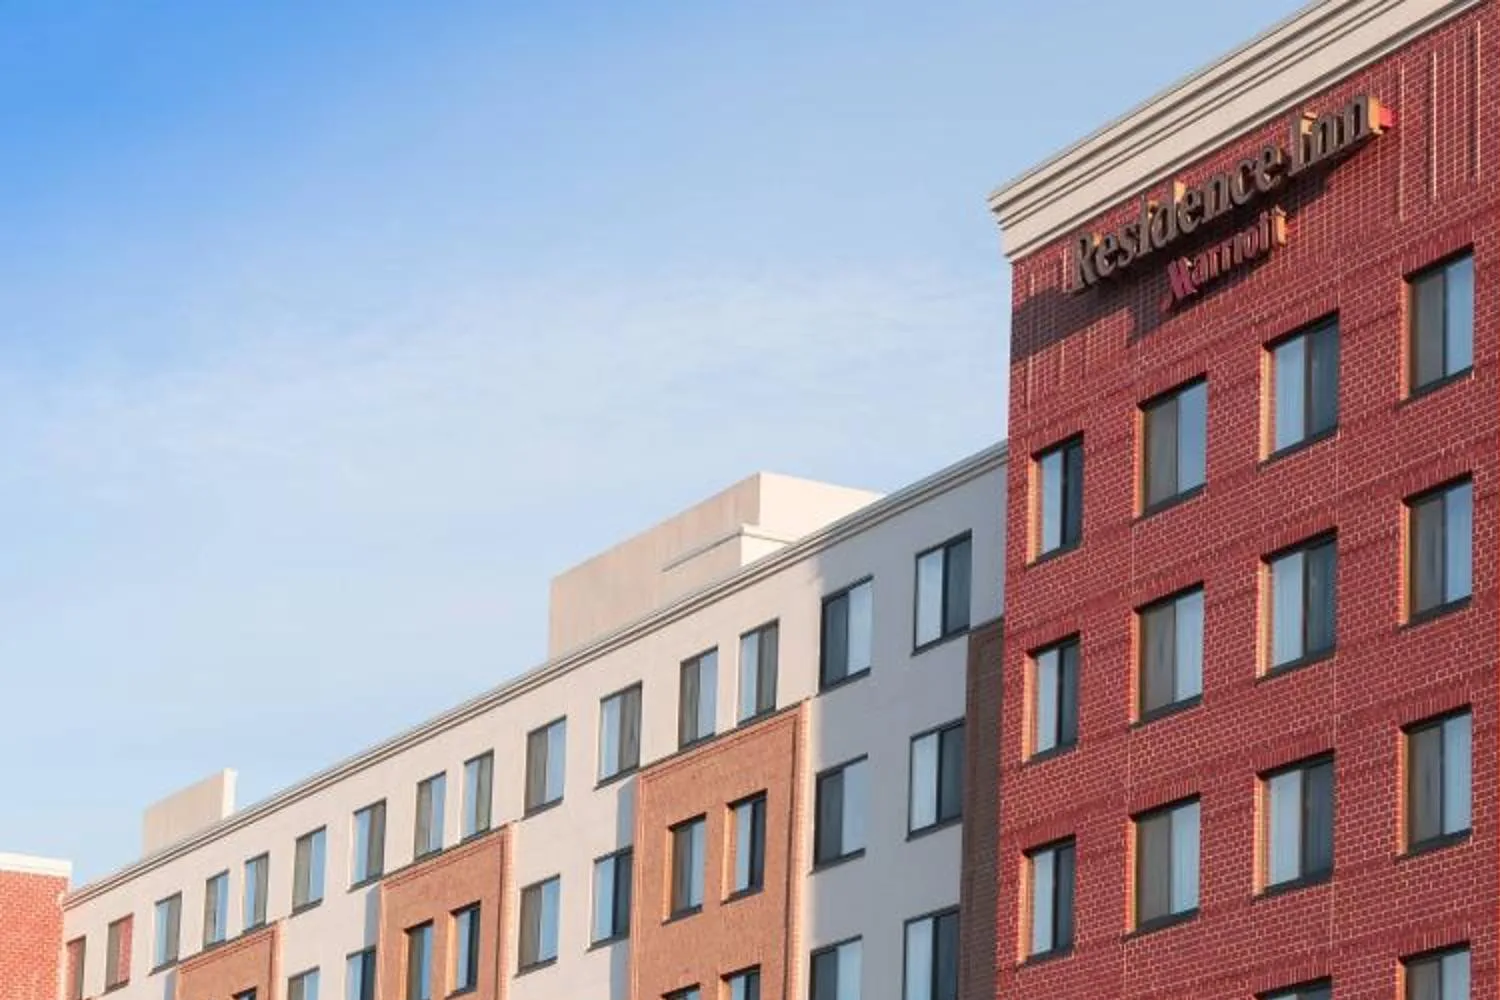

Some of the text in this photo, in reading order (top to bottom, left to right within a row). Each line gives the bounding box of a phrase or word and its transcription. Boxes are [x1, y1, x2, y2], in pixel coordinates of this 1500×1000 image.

[1069, 95, 1382, 293] Residence Inn
[1166, 205, 1287, 299] Marriott
